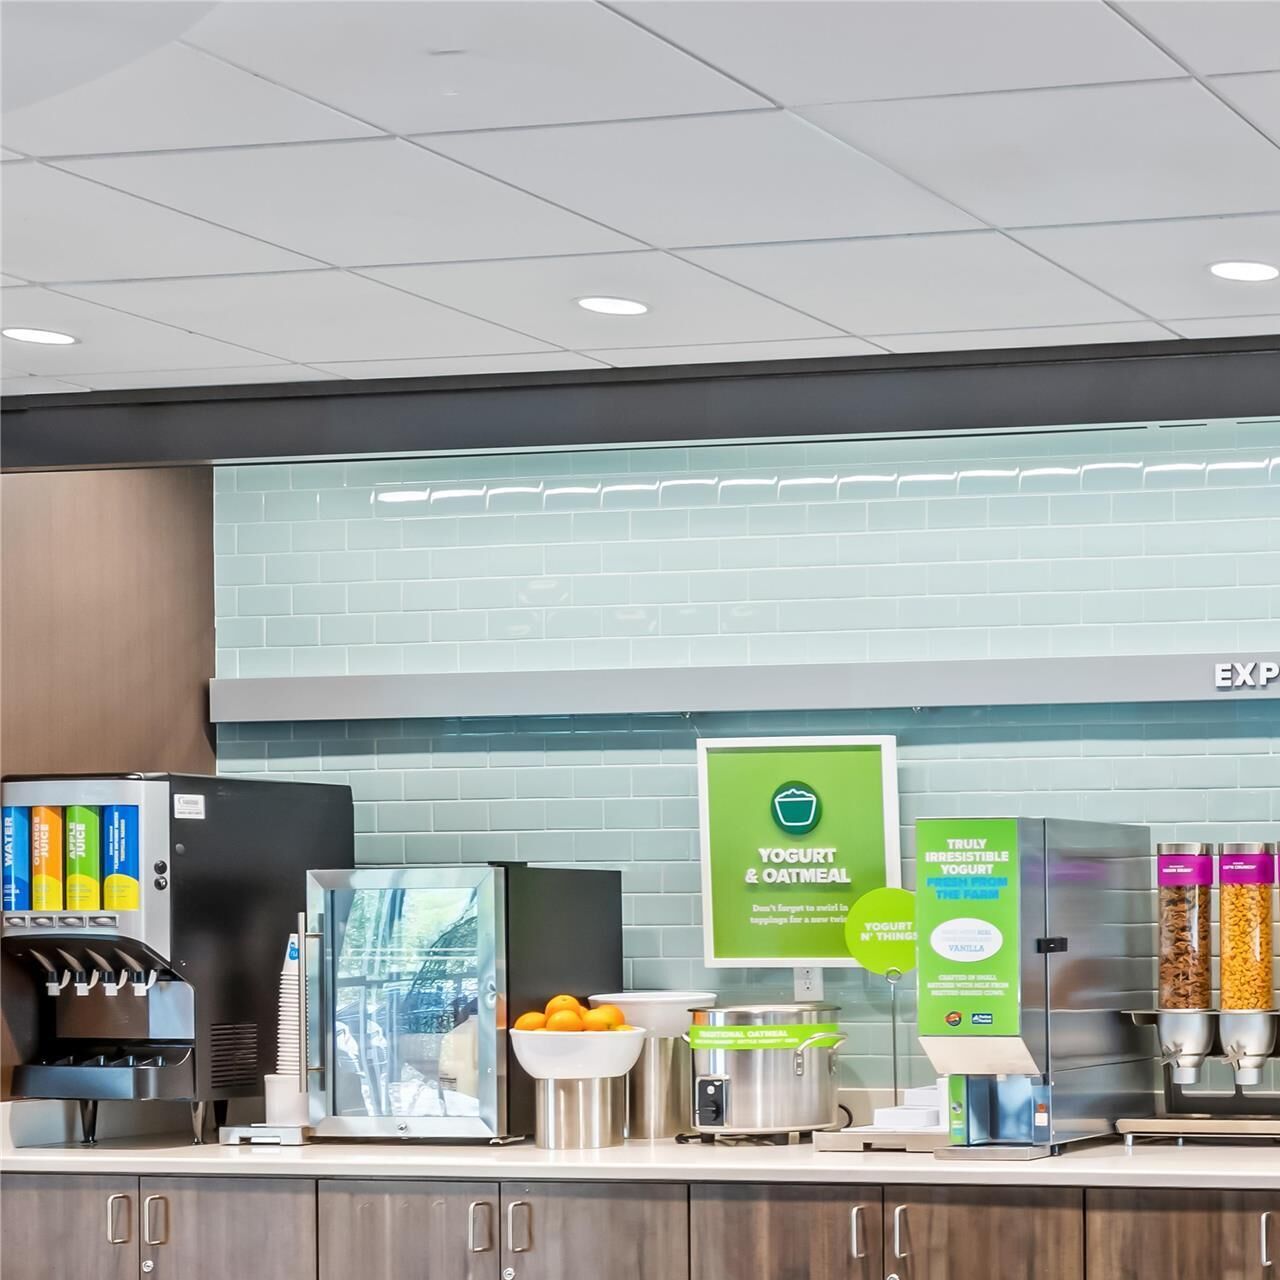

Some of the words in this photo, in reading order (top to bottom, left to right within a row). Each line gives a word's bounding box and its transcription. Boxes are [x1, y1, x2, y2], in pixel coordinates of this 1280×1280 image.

[4, 817, 13, 867] WATER
[40, 823, 49, 858] JUICE
[76, 823, 86, 857] JUICE
[946, 838, 987, 849] TRULY
[758, 848, 837, 863] YOGURT
[925, 850, 1009, 862] IRRESISTIBLE
[941, 863, 993, 875] YOGURT
[745, 868, 759, 883] &
[762, 868, 851, 884] OATMEAL
[777, 903, 804, 913] forget
[806, 904, 815, 912] to
[839, 903, 849, 912] in
[789, 915, 802, 923] for
[864, 922, 912, 932] YOGURT
[860, 932, 873, 941] N'
[948, 944, 985, 952] VANILLA
